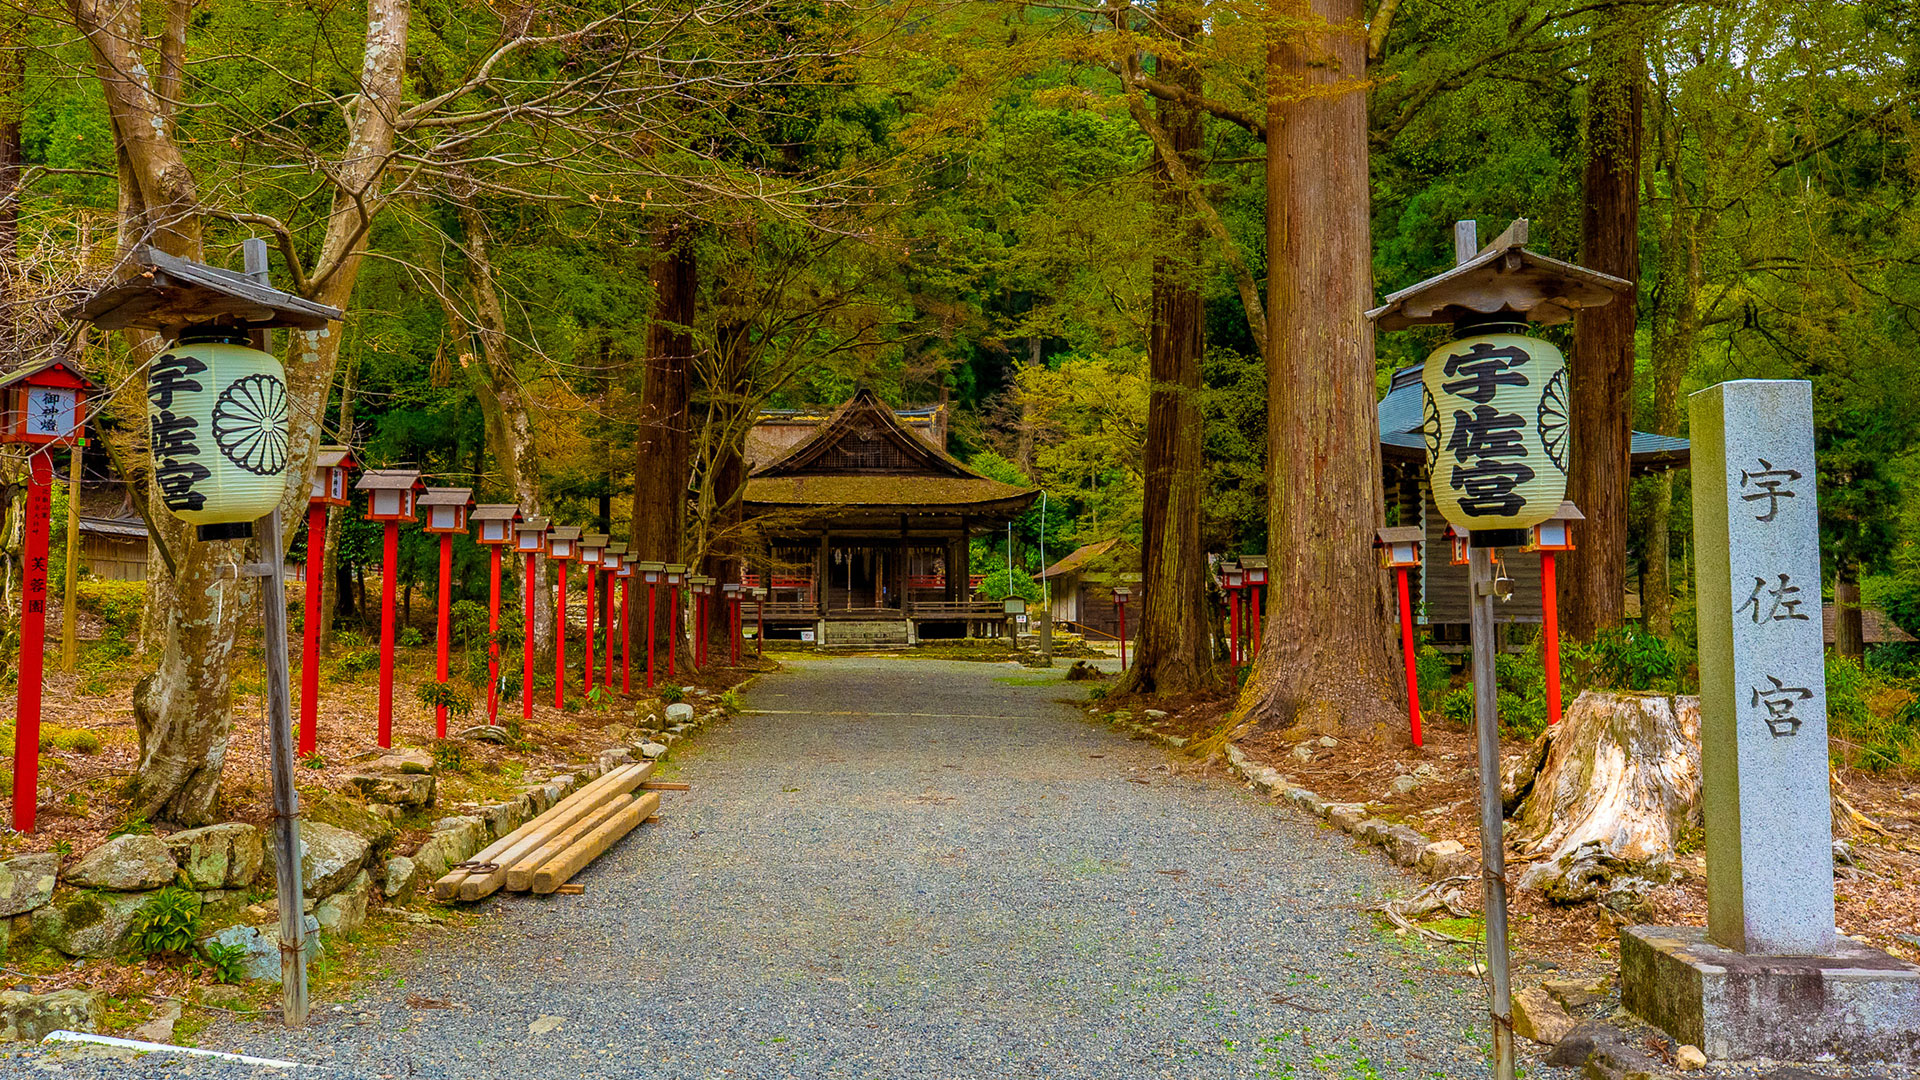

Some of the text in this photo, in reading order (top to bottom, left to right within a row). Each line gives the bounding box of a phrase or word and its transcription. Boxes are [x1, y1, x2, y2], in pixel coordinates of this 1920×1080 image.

[148, 354, 212, 512] 宇佐宮
[1442, 343, 1535, 518] 宇佐宮
[29, 556, 46, 613] 芙蓉園
[1736, 458, 1814, 739] 宇佐宮
